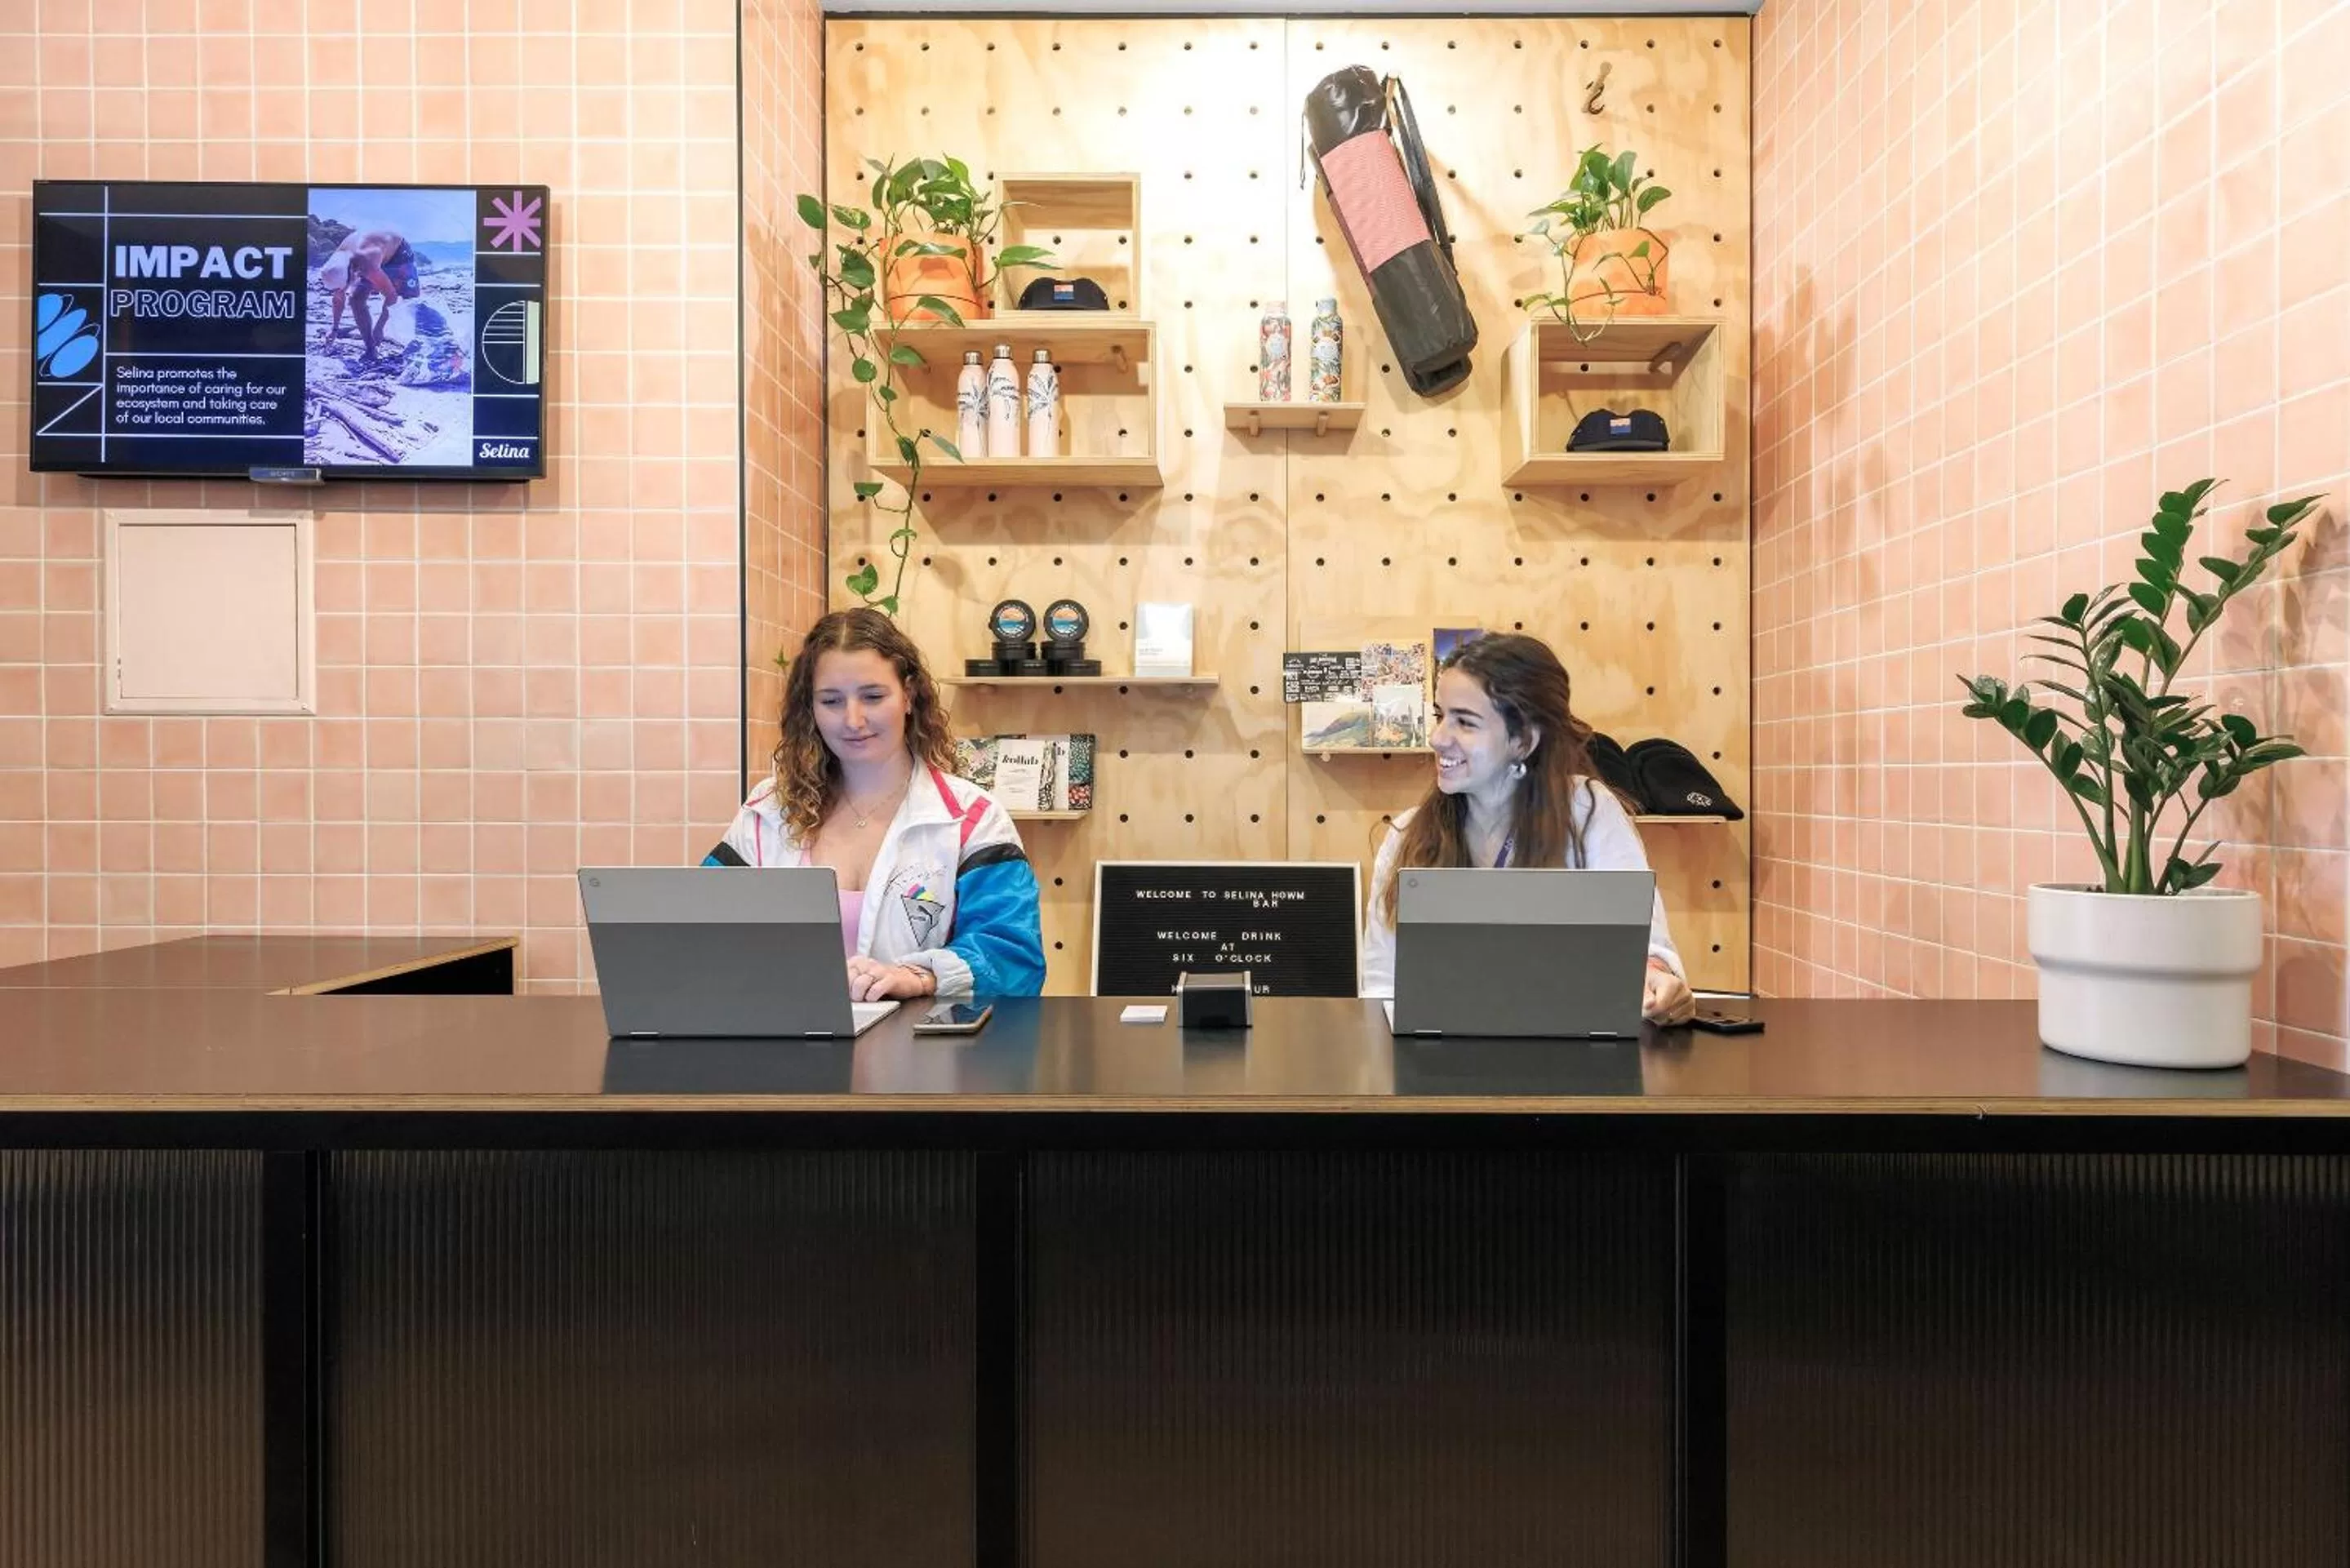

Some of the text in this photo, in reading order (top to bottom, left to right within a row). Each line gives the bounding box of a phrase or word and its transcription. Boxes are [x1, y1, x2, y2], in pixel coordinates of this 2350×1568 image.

[115, 245, 293, 278] IMPACT
[110, 289, 295, 318] PROGRAM
[116, 366, 237, 381] Selina promotes the
[117, 382, 287, 398] importance of caring for our
[116, 397, 278, 412] ecosystem and taking care
[115, 411, 265, 425] of our local communities.
[479, 442, 530, 458] Selina
[1135, 890, 1192, 899] WELCOME
[1202, 891, 1216, 899] TO
[1224, 891, 1265, 900] SELINA
[1157, 931, 1282, 941] WELCOME DRINK
[1220, 942, 1235, 952] AT
[1171, 953, 1273, 963] SIX O'CLOCK
